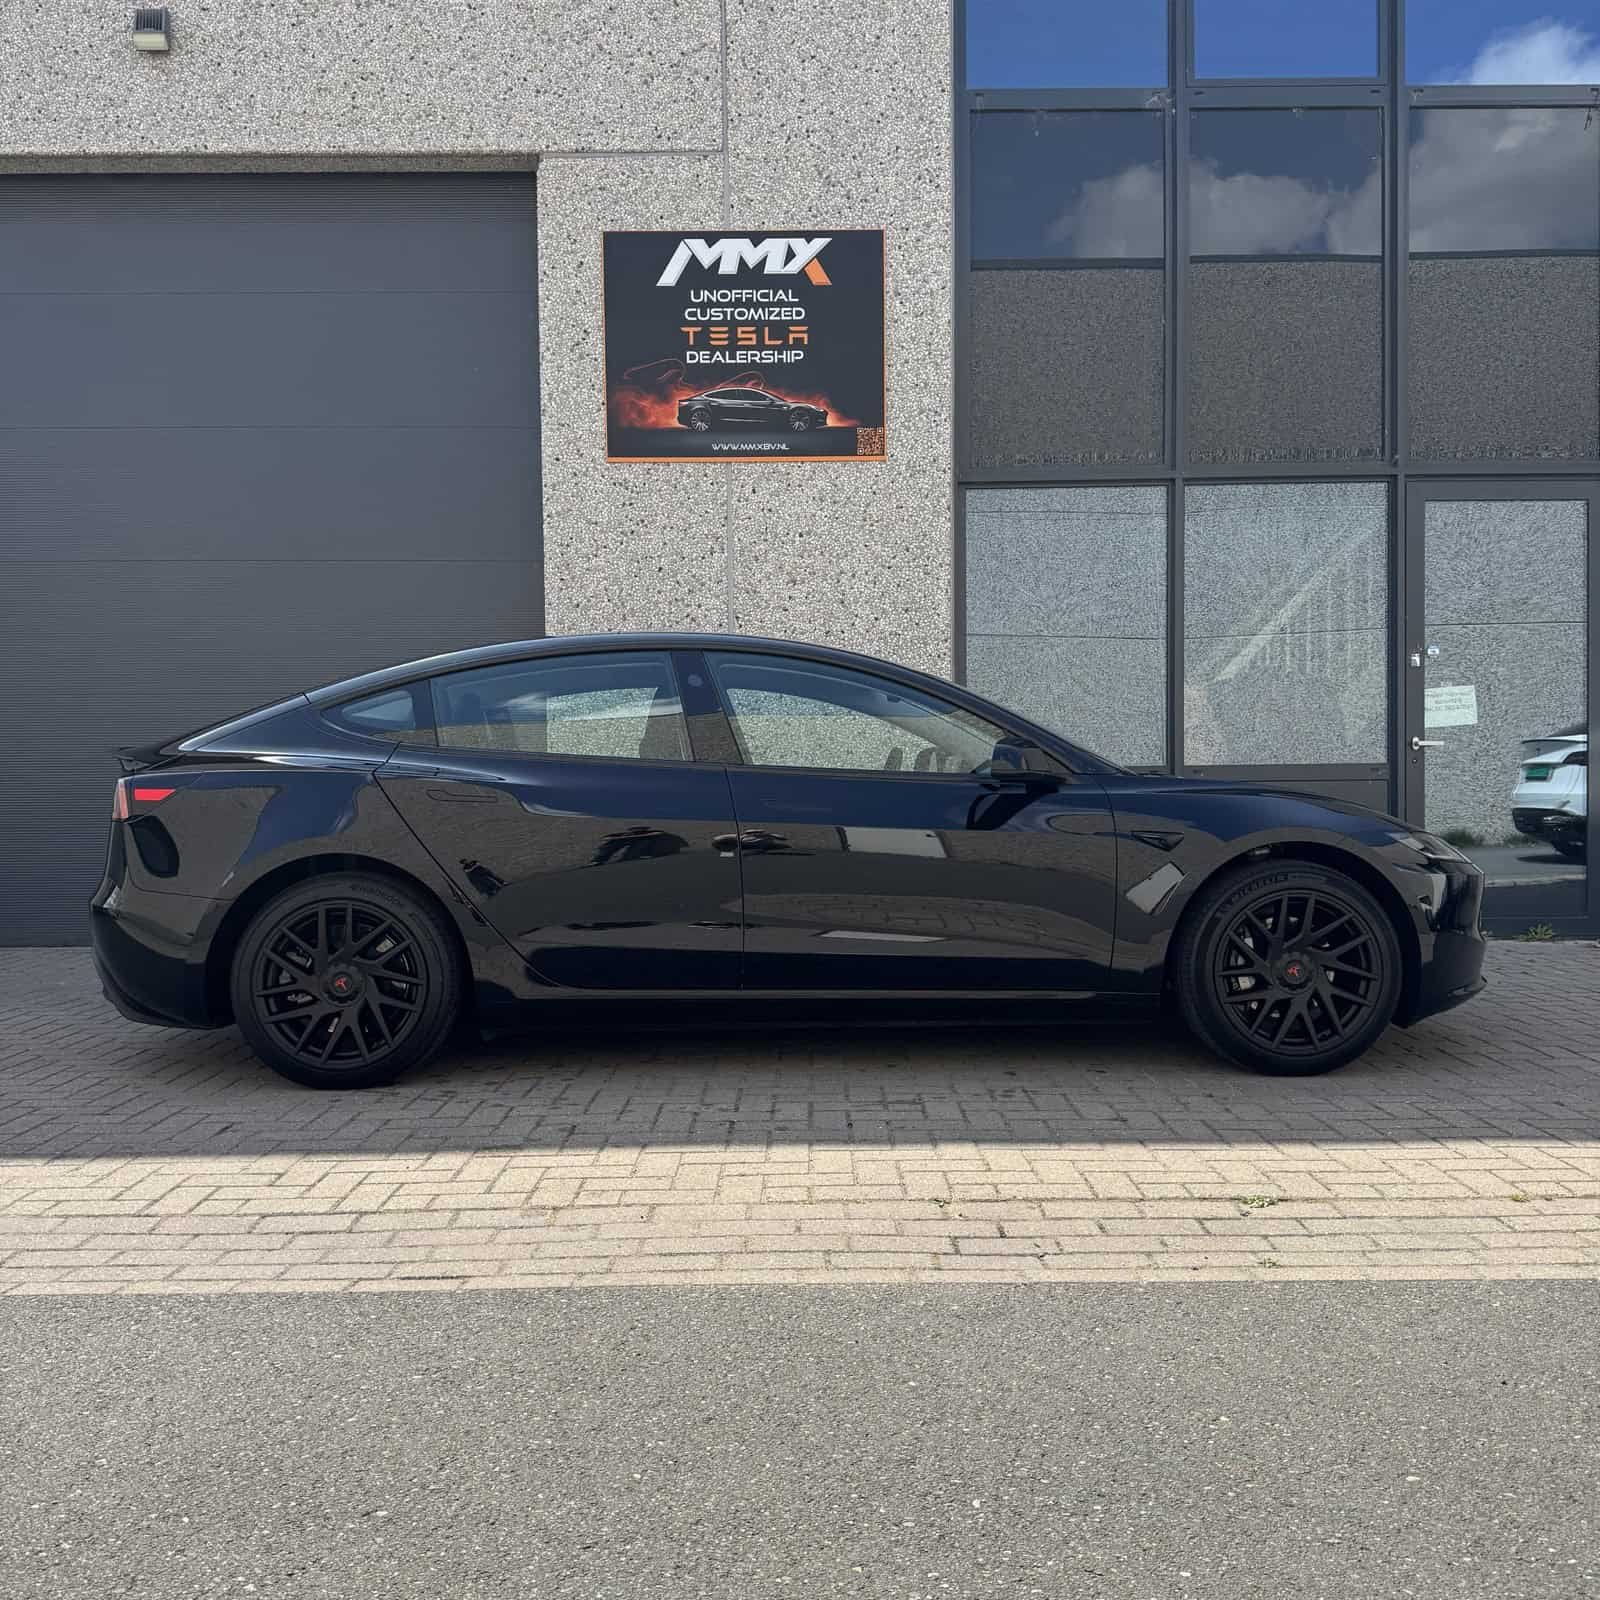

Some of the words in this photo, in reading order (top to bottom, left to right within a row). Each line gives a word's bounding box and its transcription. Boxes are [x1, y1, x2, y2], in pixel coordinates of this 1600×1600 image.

[655, 237, 833, 287] MMX
[690, 288, 800, 303] UNOFFICIAL
[684, 306, 806, 321] CUSTOMIZED
[680, 325, 809, 346] TESLA
[686, 350, 805, 364] DEALERSHIP
